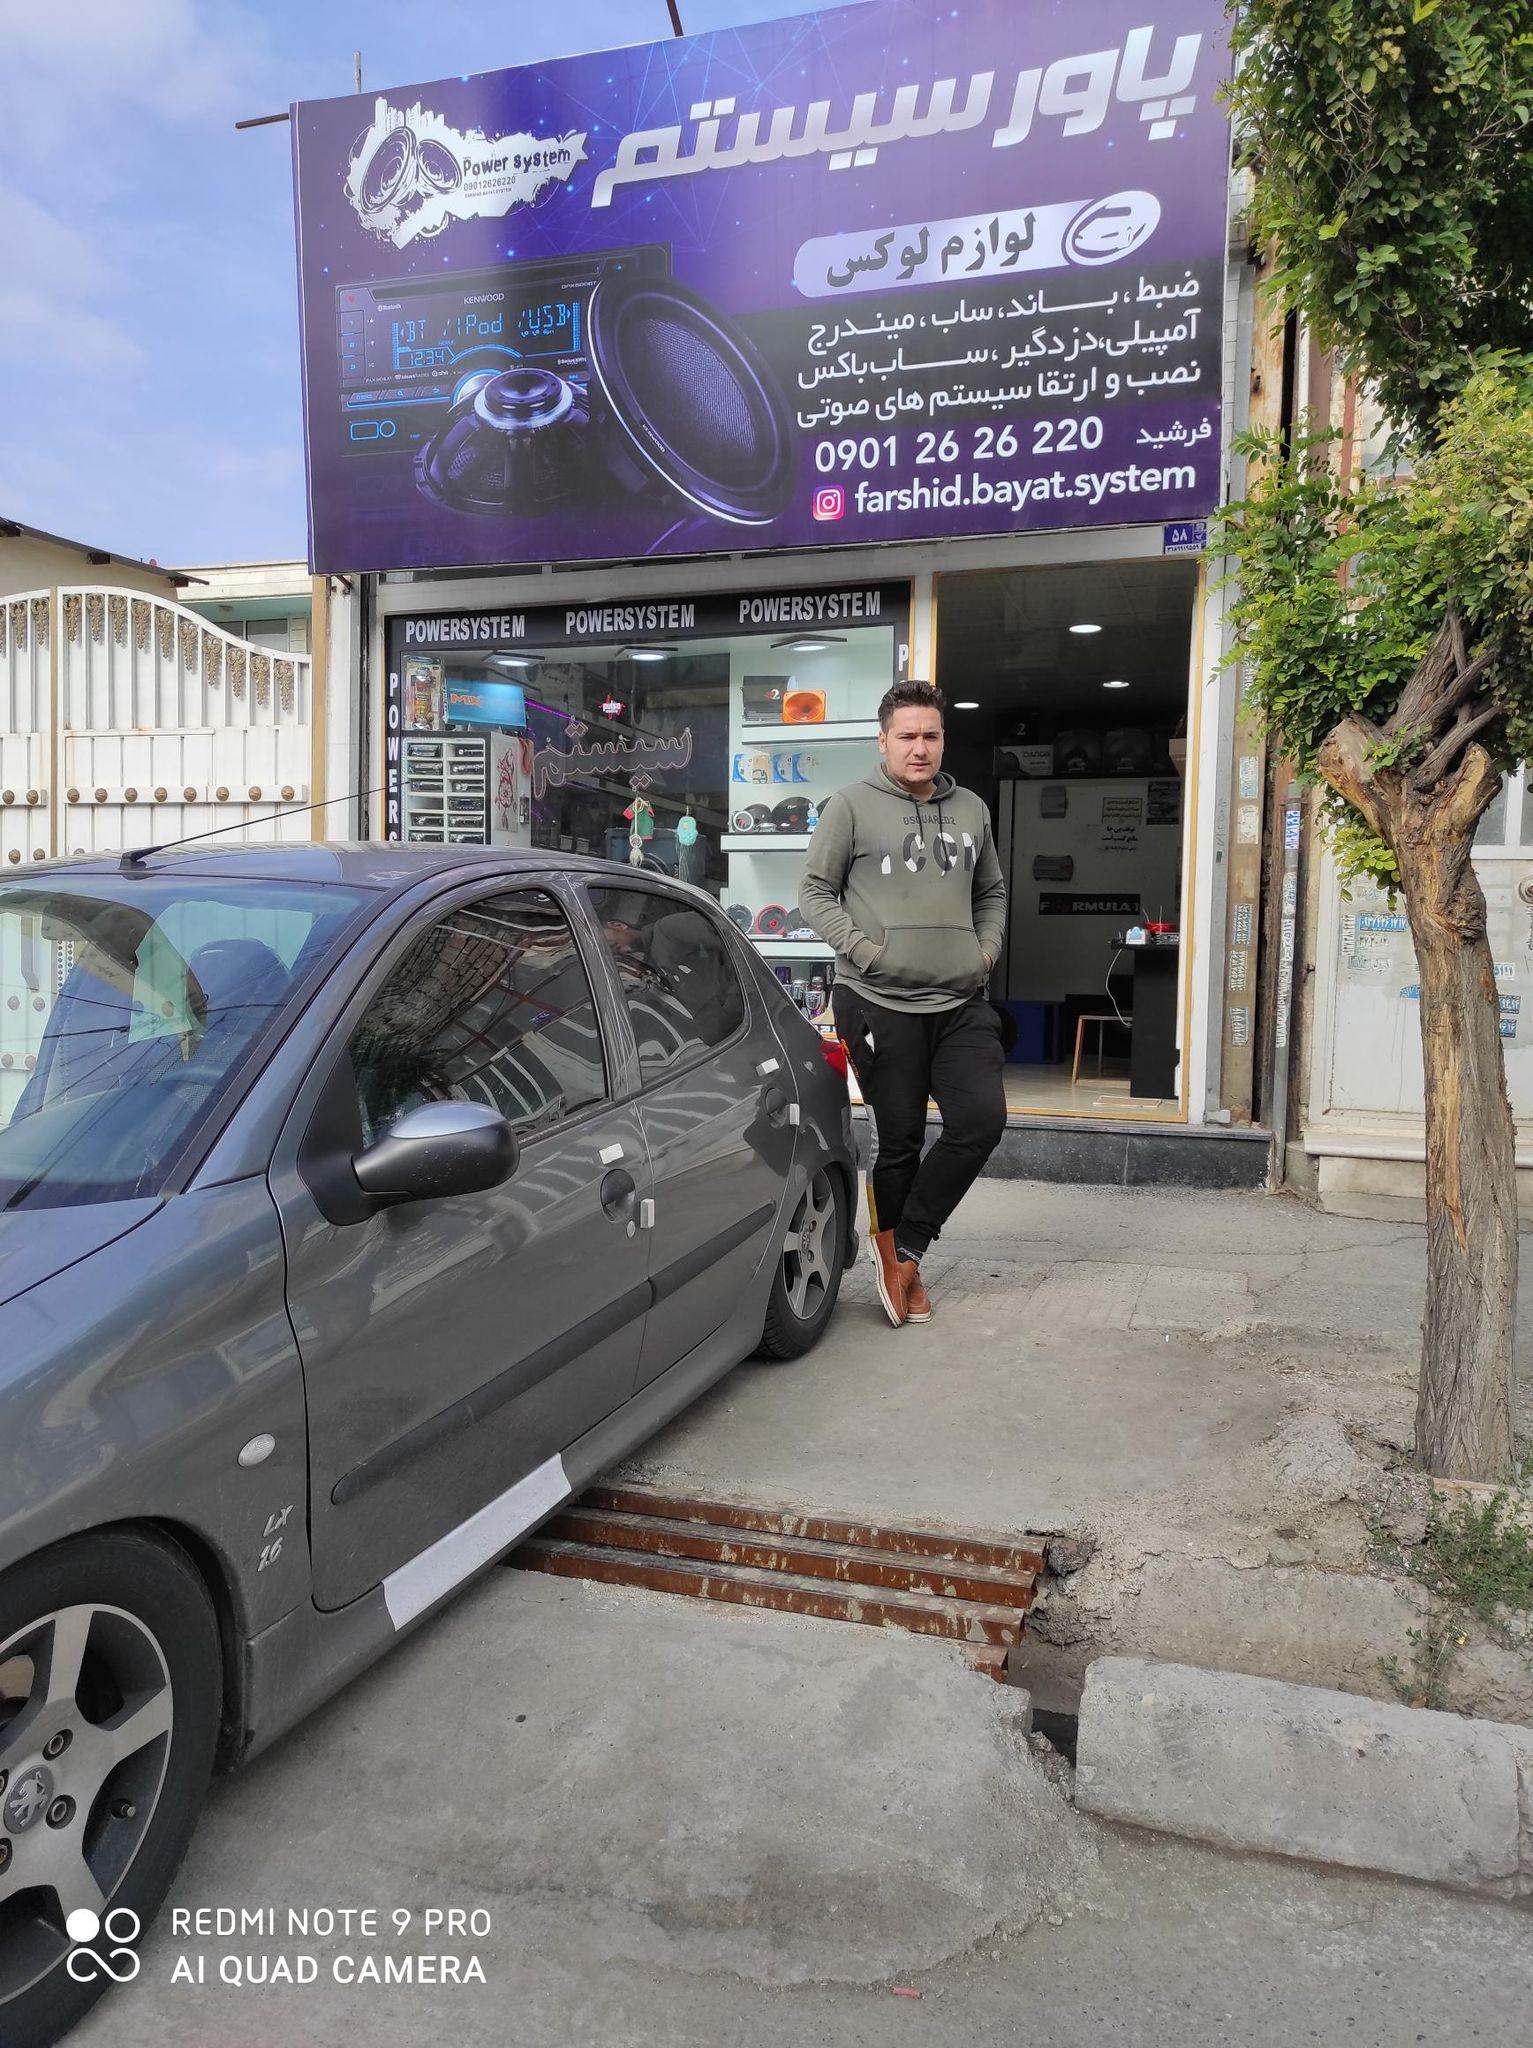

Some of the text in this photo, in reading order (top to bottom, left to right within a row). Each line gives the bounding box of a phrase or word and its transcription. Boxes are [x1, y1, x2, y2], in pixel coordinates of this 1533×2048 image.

[591, 25, 1203, 208] پاور سیستم
[463, 156, 508, 176] Power
[464, 176, 516, 191] 09012626220
[826, 212, 1036, 288] لوازم لوکس
[463, 292, 505, 305] KENWOOD
[406, 320, 426, 342] BT
[528, 303, 566, 329] USB
[797, 360, 1201, 429] نصب و ارتقا سیستم های صوتی
[815, 415, 1104, 473] 0901 26 26 220
[1136, 417, 1212, 450] فرشید
[854, 464, 1196, 513] farshid.bayat.system
[1172, 528, 1188, 543] ۵۸
[565, 604, 696, 635] POWERSYSTEM
[739, 591, 881, 624] POWERSYSTEM
[405, 615, 525, 643] POWERSYSTEM
[533, 721, 693, 800] سیستم
